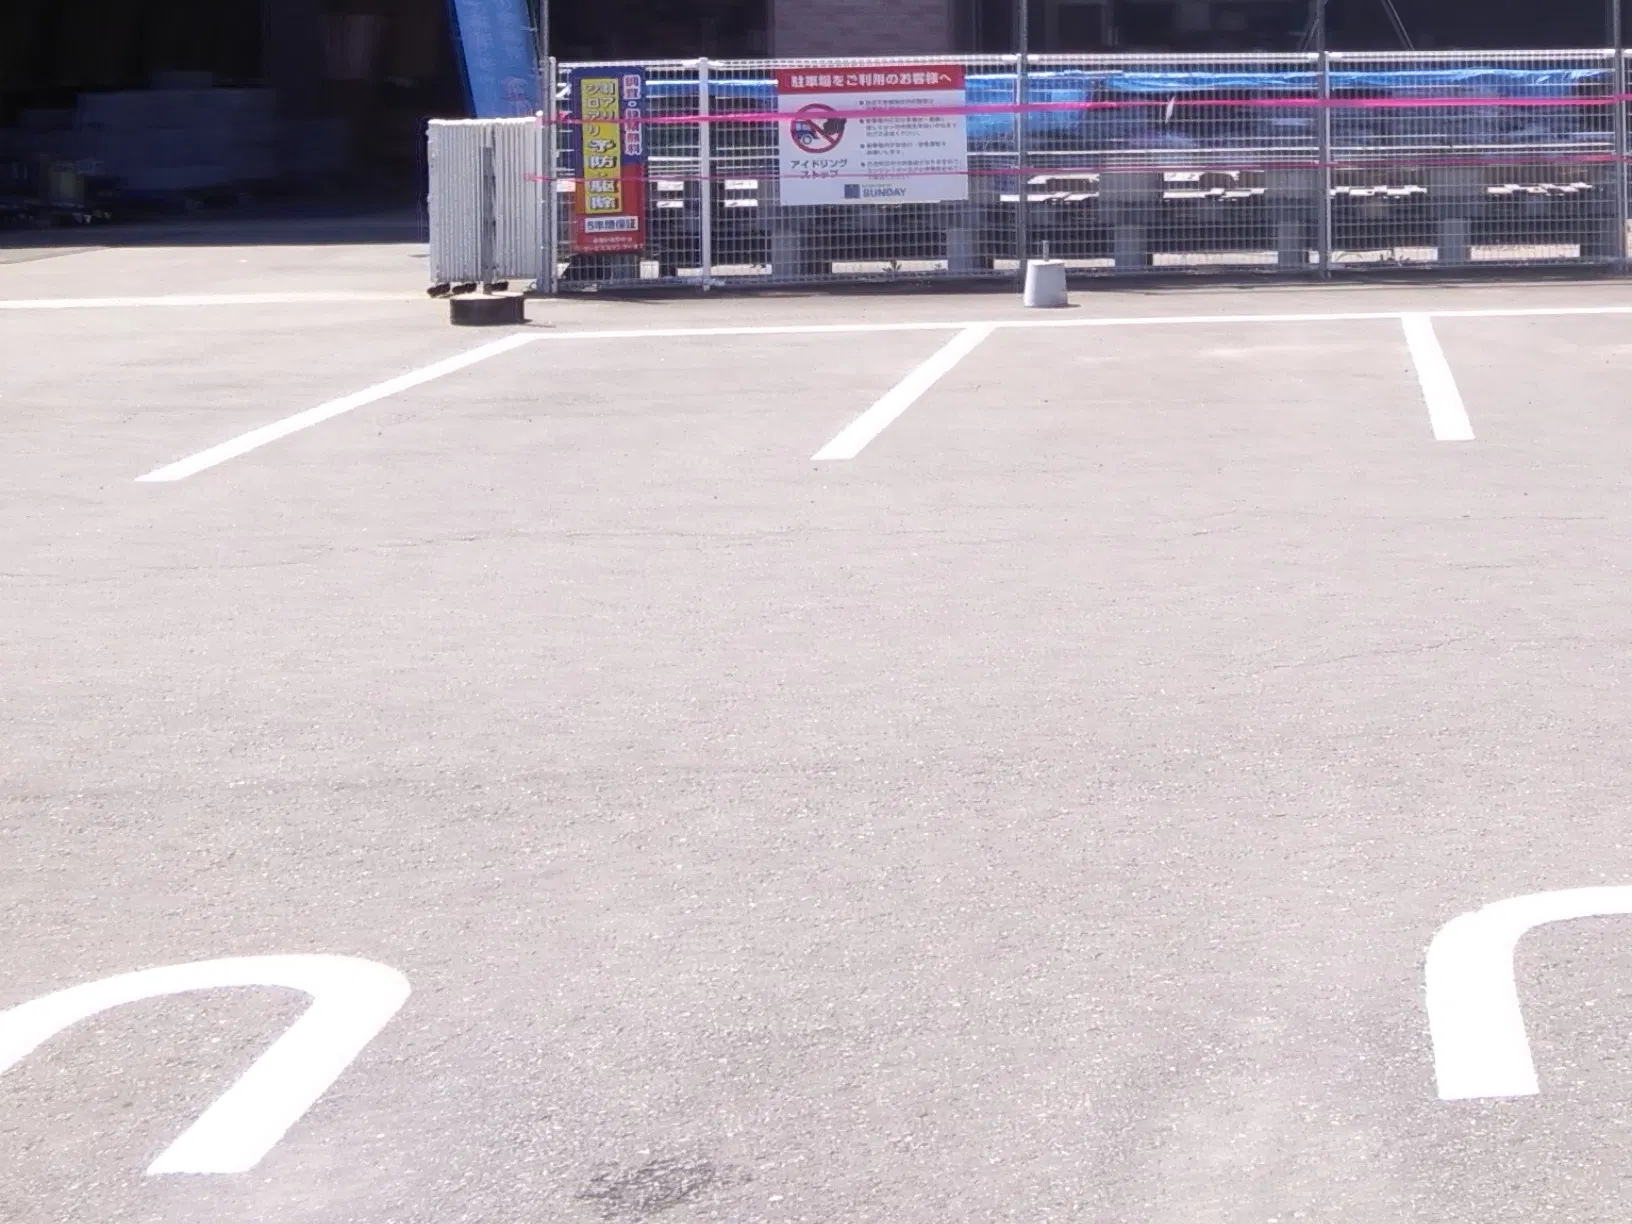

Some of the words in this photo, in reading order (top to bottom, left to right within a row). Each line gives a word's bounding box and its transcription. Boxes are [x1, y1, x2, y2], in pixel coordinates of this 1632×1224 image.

[790, 158, 848, 169] アイドリング
[863, 187, 907, 198] SUNDAY
